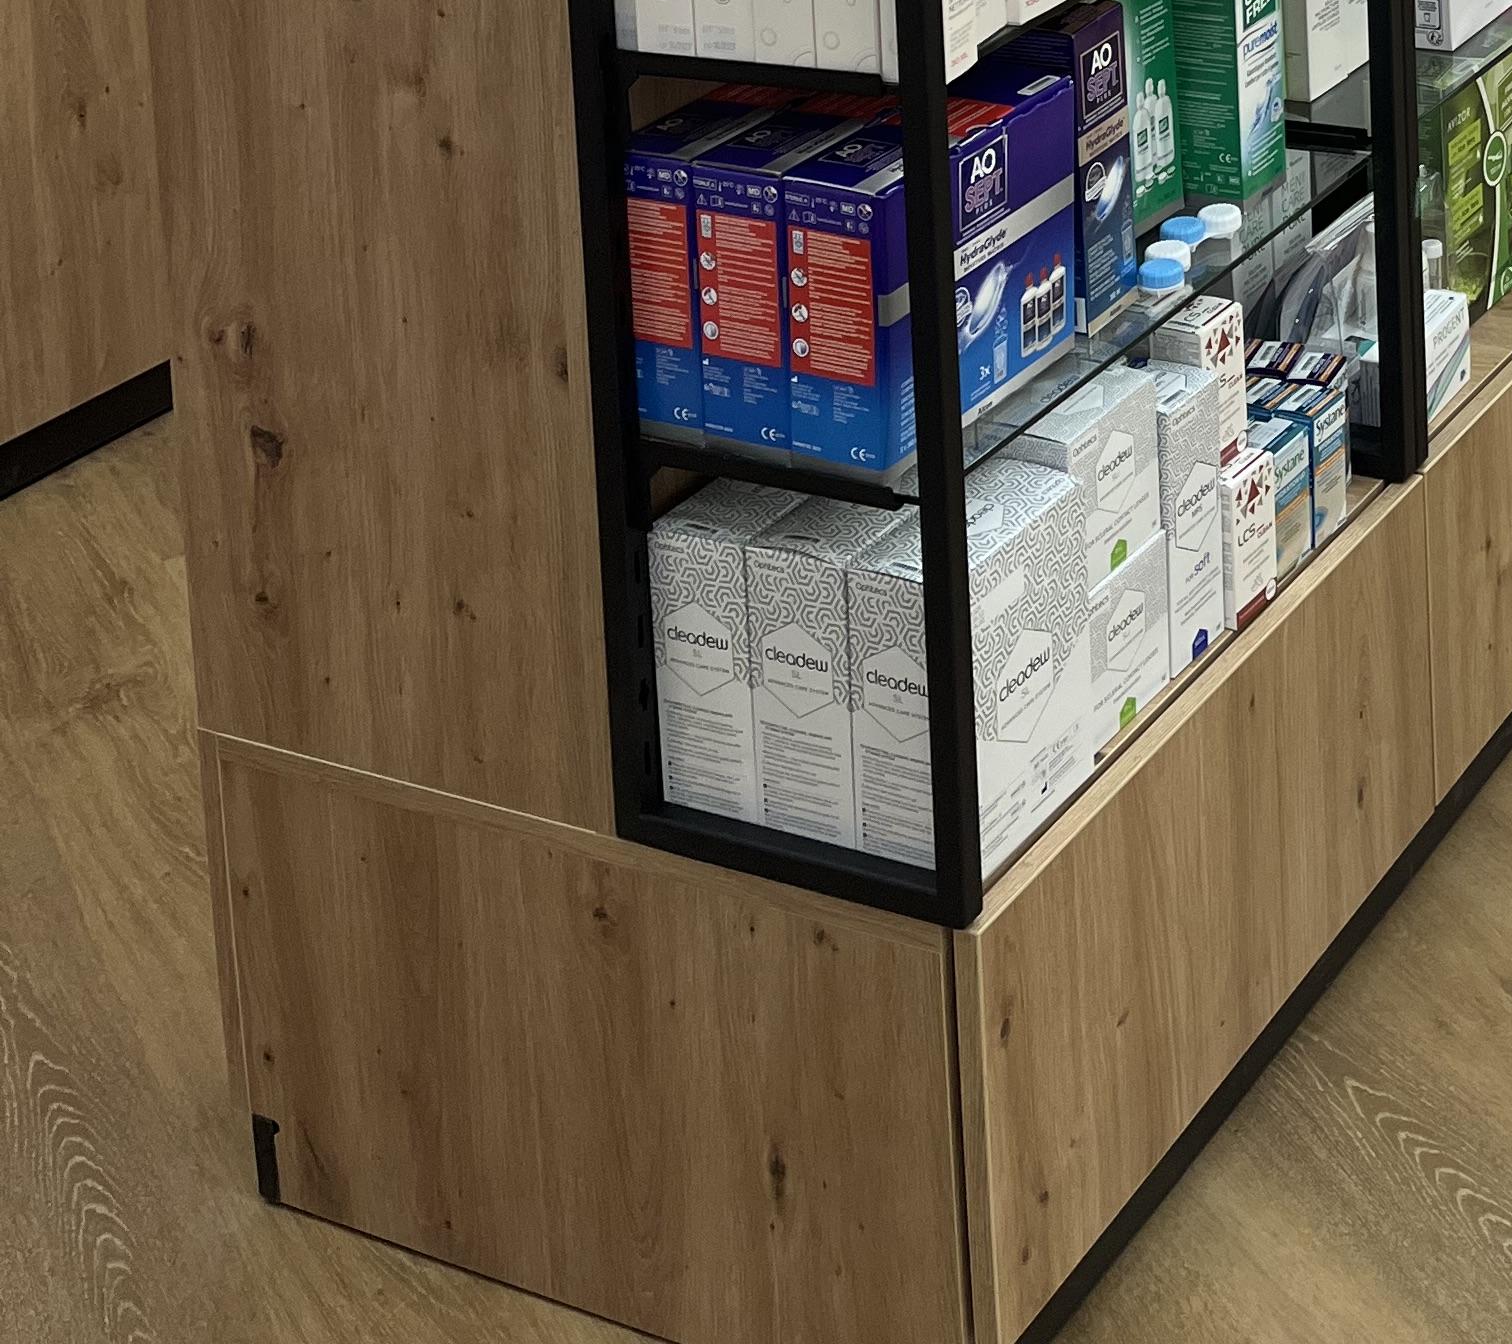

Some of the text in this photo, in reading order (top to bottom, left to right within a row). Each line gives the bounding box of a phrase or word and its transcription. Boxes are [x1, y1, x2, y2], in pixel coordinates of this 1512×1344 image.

[1091, 42, 1112, 75] AO
[1086, 61, 1120, 103] SEPT
[1085, 118, 1125, 152] HydraGlyde
[970, 148, 996, 184] AO
[964, 167, 1003, 213] SEPT
[959, 228, 1008, 267] HydraGlyde
[1432, 306, 1466, 349] PROGENT
[979, 364, 992, 381] 3x
[1315, 403, 1345, 442] Systane
[1097, 445, 1133, 482] cleadew
[1273, 448, 1305, 489] Systane
[1177, 477, 1216, 518] cleadew
[1237, 522, 1256, 548] LCS
[1194, 551, 1211, 577] soft
[667, 626, 729, 650] cleadew
[1108, 601, 1144, 643] cleadew
[764, 646, 829, 673] cleadew
[1000, 646, 1051, 702] cleadew
